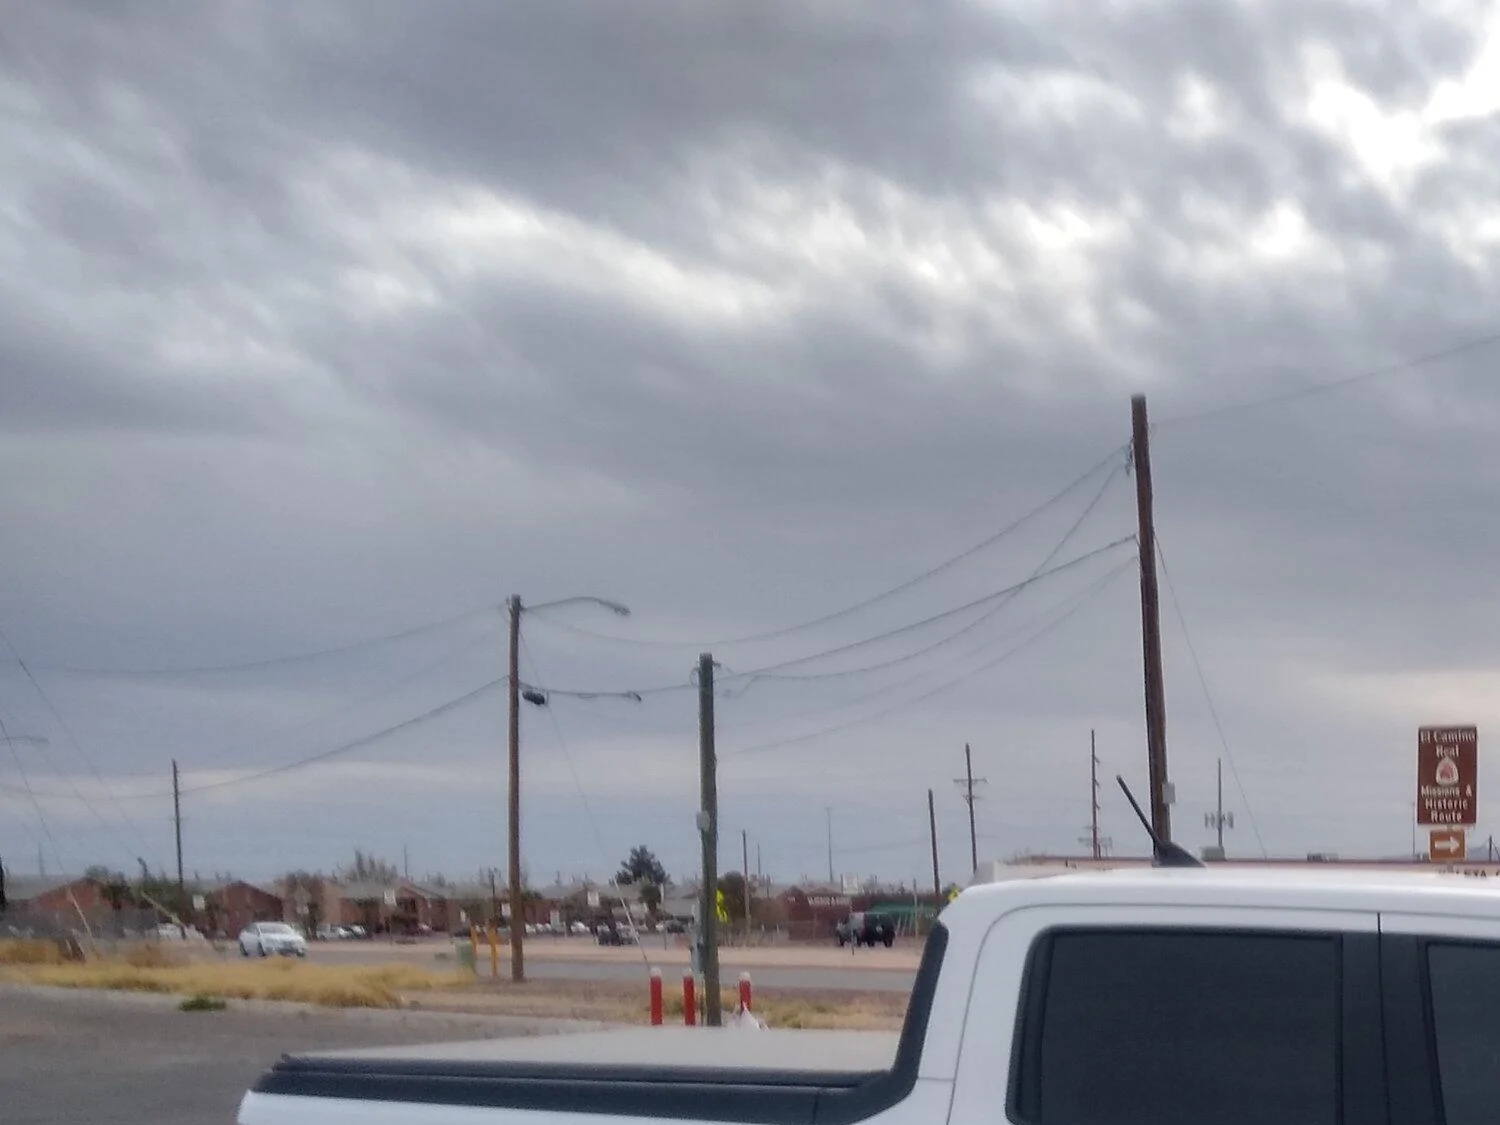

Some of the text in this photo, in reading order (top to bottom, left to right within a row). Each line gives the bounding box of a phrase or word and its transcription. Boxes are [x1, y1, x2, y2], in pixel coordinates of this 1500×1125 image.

[1433, 730, 1476, 743] Camino
[1436, 744, 1459, 758] Real
[1421, 784, 1460, 798] Missions
[1425, 798, 1468, 811] Historic
[1430, 809, 1462, 823] Route
